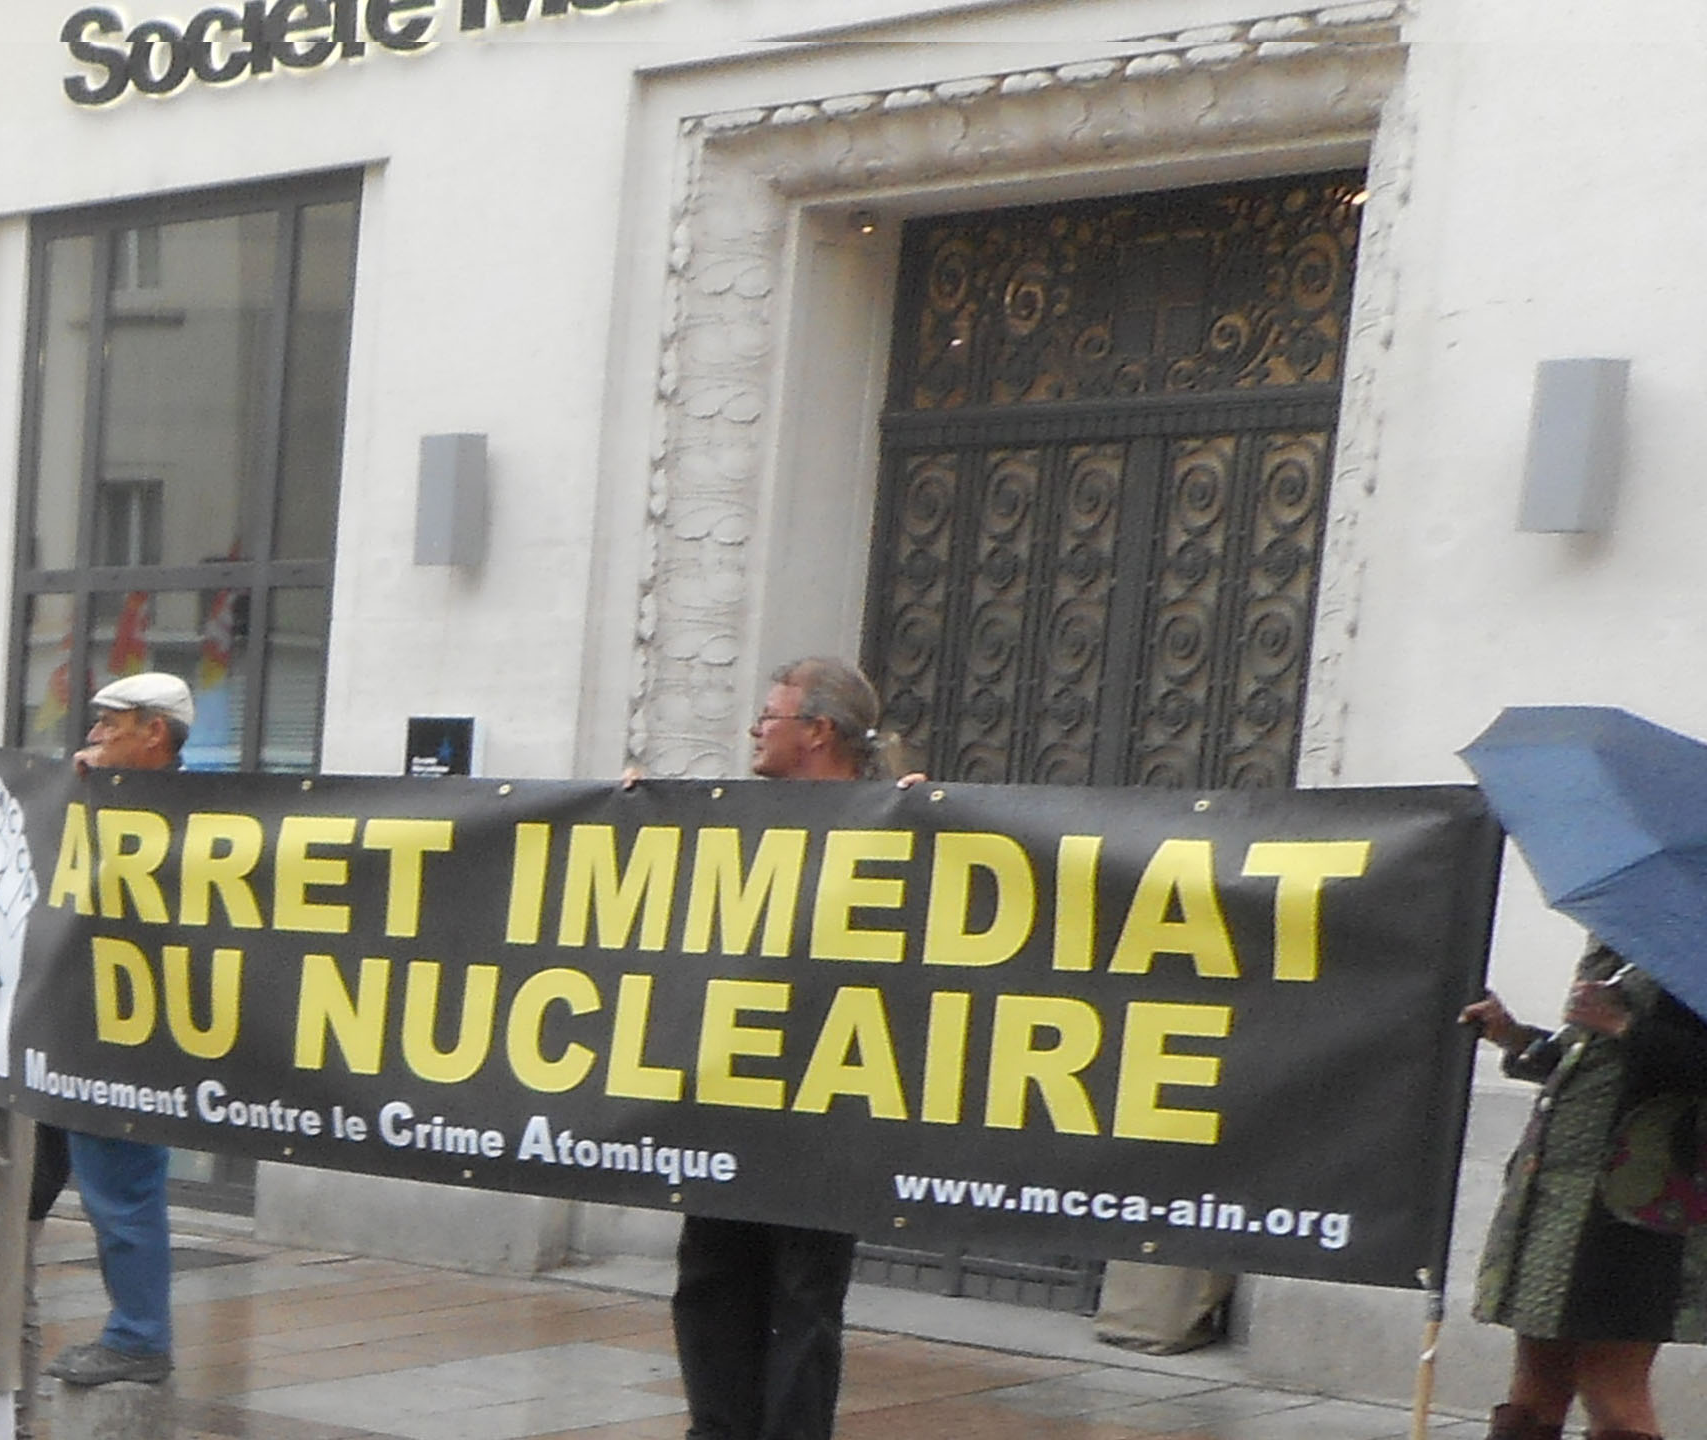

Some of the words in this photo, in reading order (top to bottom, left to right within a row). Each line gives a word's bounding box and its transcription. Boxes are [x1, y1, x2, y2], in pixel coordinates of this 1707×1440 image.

[47, 802, 454, 938] ARRET
[505, 821, 1372, 984] IMMEDIAT
[24, 1048, 188, 1119] Mouvement
[196, 1079, 322, 1141] Contre
[331, 1105, 367, 1142] le
[379, 1100, 504, 1158] Crime
[518, 1115, 736, 1186] Atomique
[92, 936, 243, 1060] DU
[295, 954, 1234, 1146] NUCLEAIRE
[894, 1171, 1351, 1250] www.mcca-ain.org
